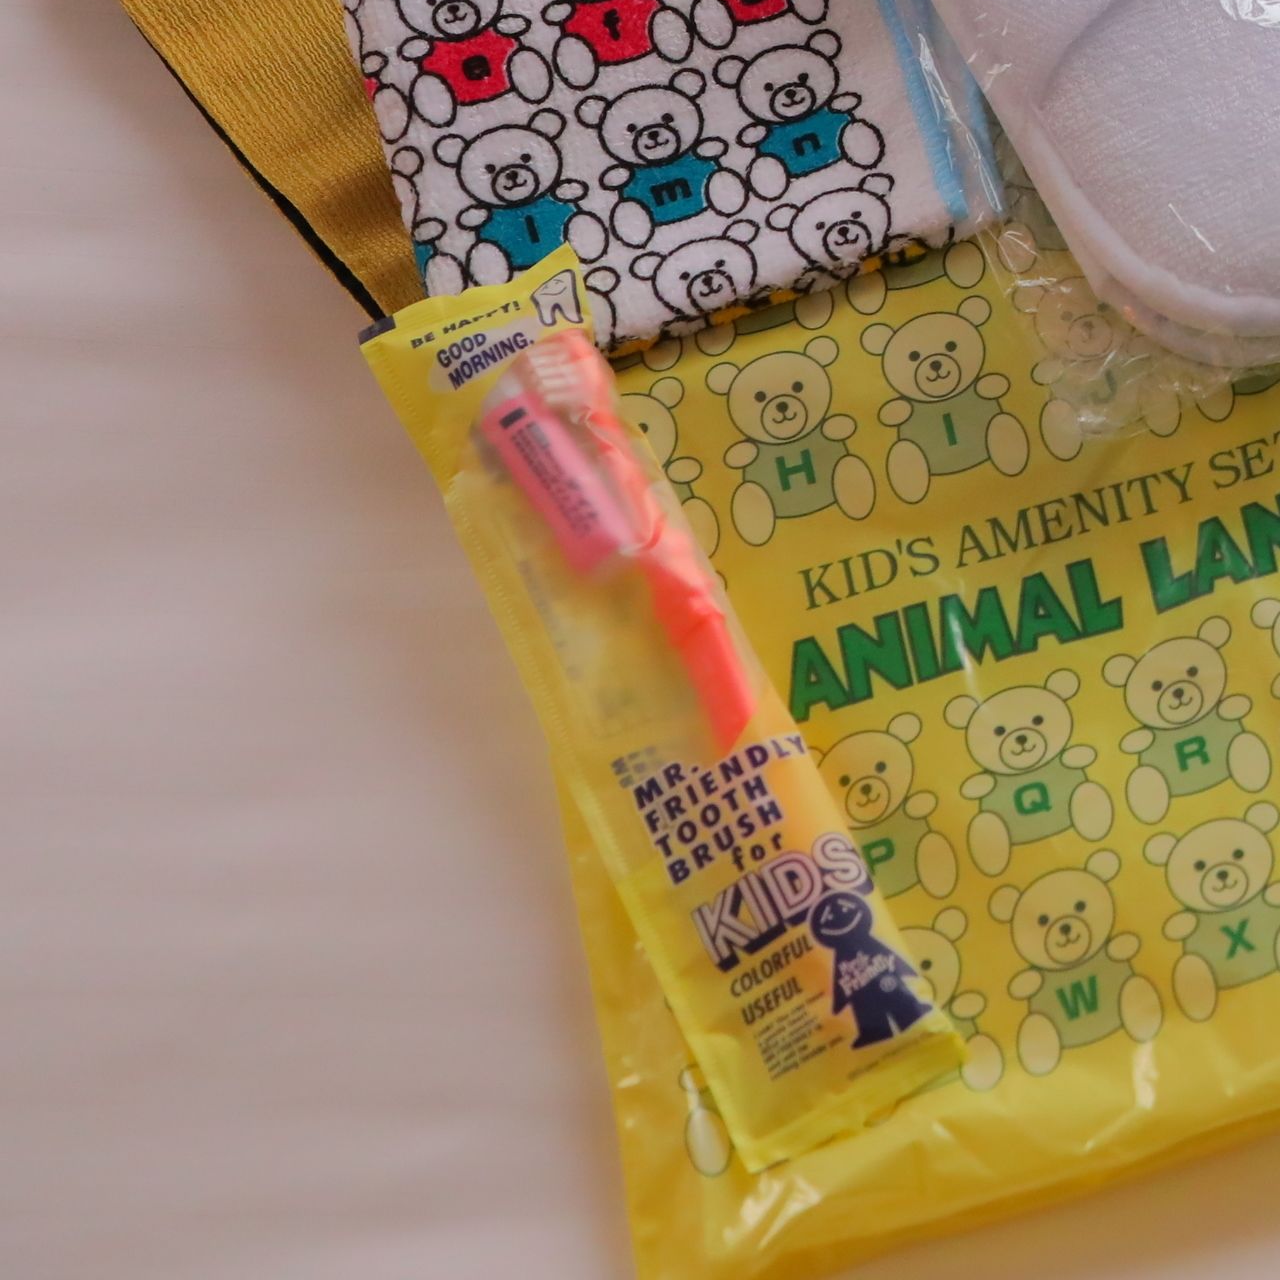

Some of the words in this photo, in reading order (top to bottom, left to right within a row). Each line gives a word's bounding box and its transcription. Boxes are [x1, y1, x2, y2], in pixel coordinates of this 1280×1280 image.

[792, 132, 821, 157] n
[650, 177, 693, 207] m
[410, 332, 436, 349] BE
[436, 333, 487, 369] GOOD
[448, 332, 535, 391] MORNING.
[775, 448, 816, 492] H
[800, 535, 941, 611] KID'S
[955, 462, 1196, 570] AMENITY
[788, 557, 1125, 723] ANIMAL
[1174, 735, 1212, 773] R
[633, 763, 699, 810] MR.
[645, 735, 806, 834] FRIENDLY
[1012, 781, 1053, 815] Q
[655, 775, 768, 857] TOOTH
[667, 801, 782, 885] BRUSH
[732, 833, 782, 872] for
[862, 837, 895, 876] P
[692, 832, 872, 972] KIDS
[1220, 919, 1256, 961] X
[730, 935, 813, 998] COLORFUL
[741, 977, 803, 1024] USEFUL
[1055, 976, 1100, 1021] W
